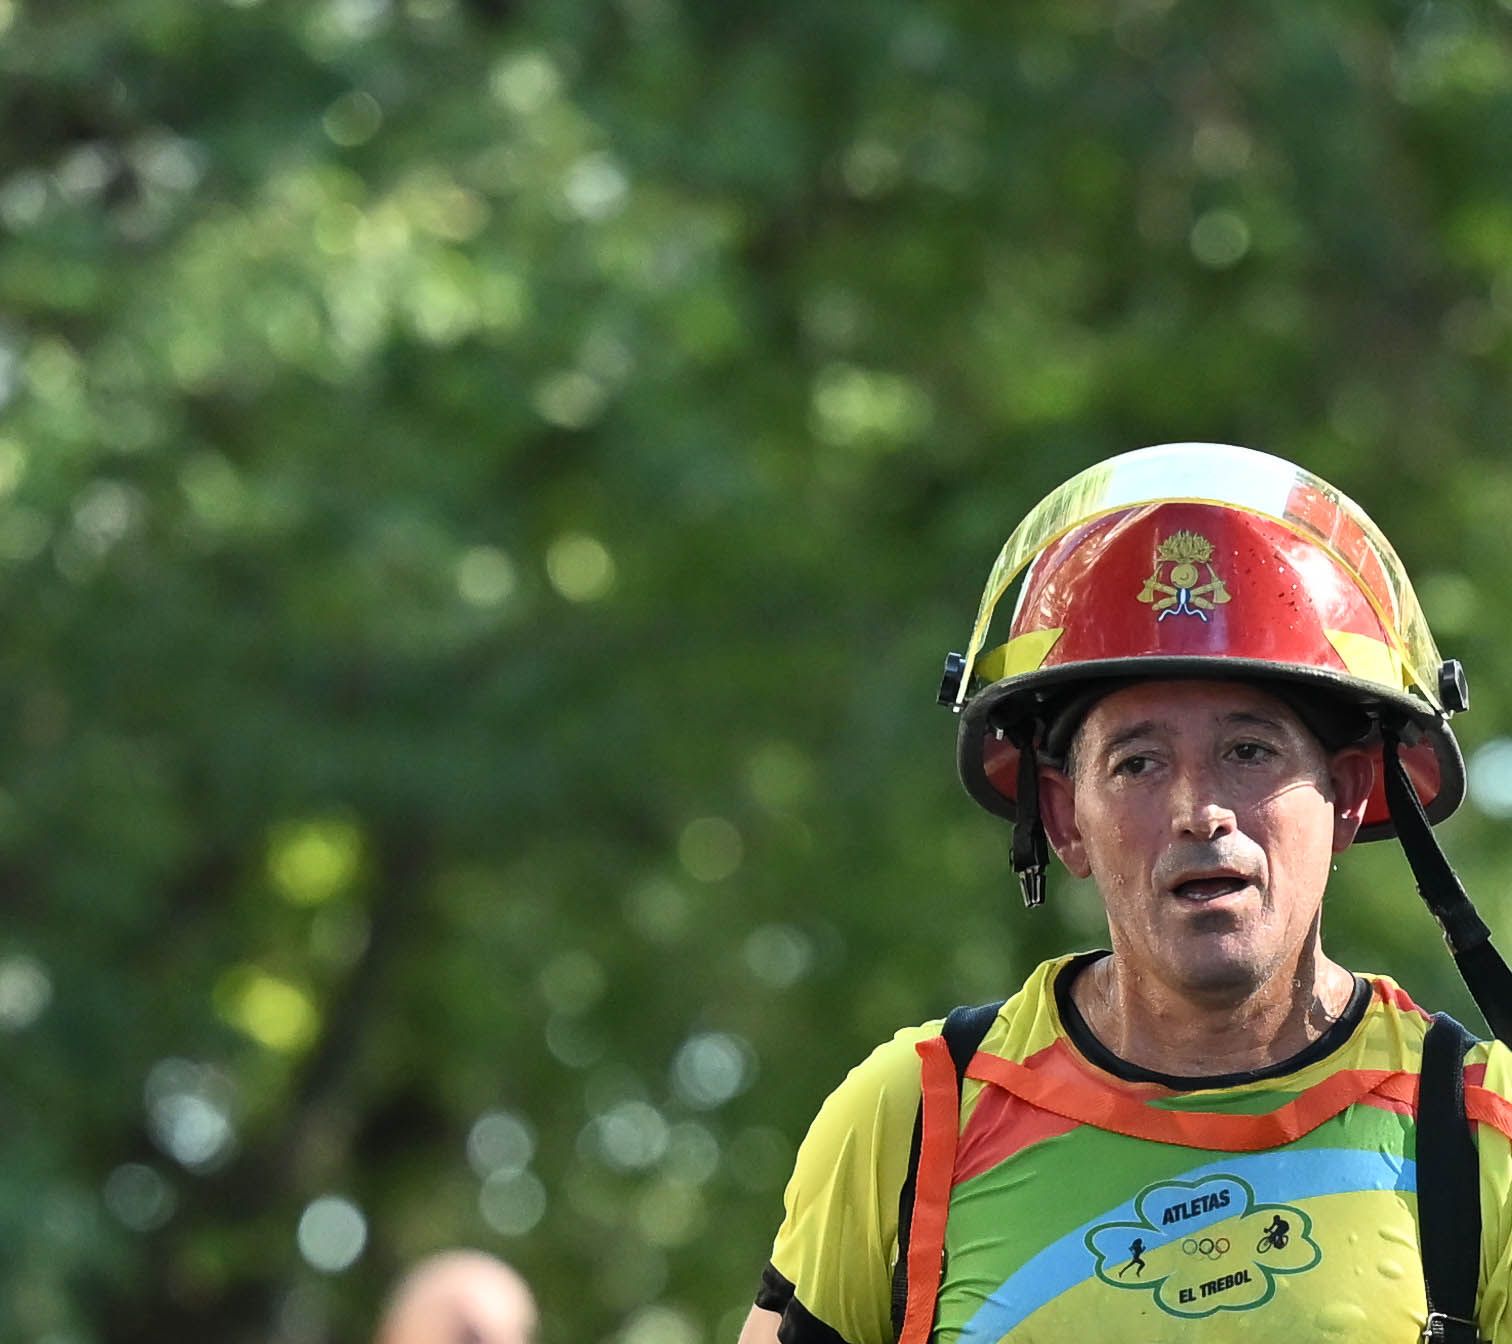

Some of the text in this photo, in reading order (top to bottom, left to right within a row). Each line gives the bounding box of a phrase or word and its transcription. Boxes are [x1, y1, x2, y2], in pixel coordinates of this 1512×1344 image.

[1162, 1189, 1231, 1225] ATLETAS
[1179, 1269, 1252, 1304] EL TREBOL
